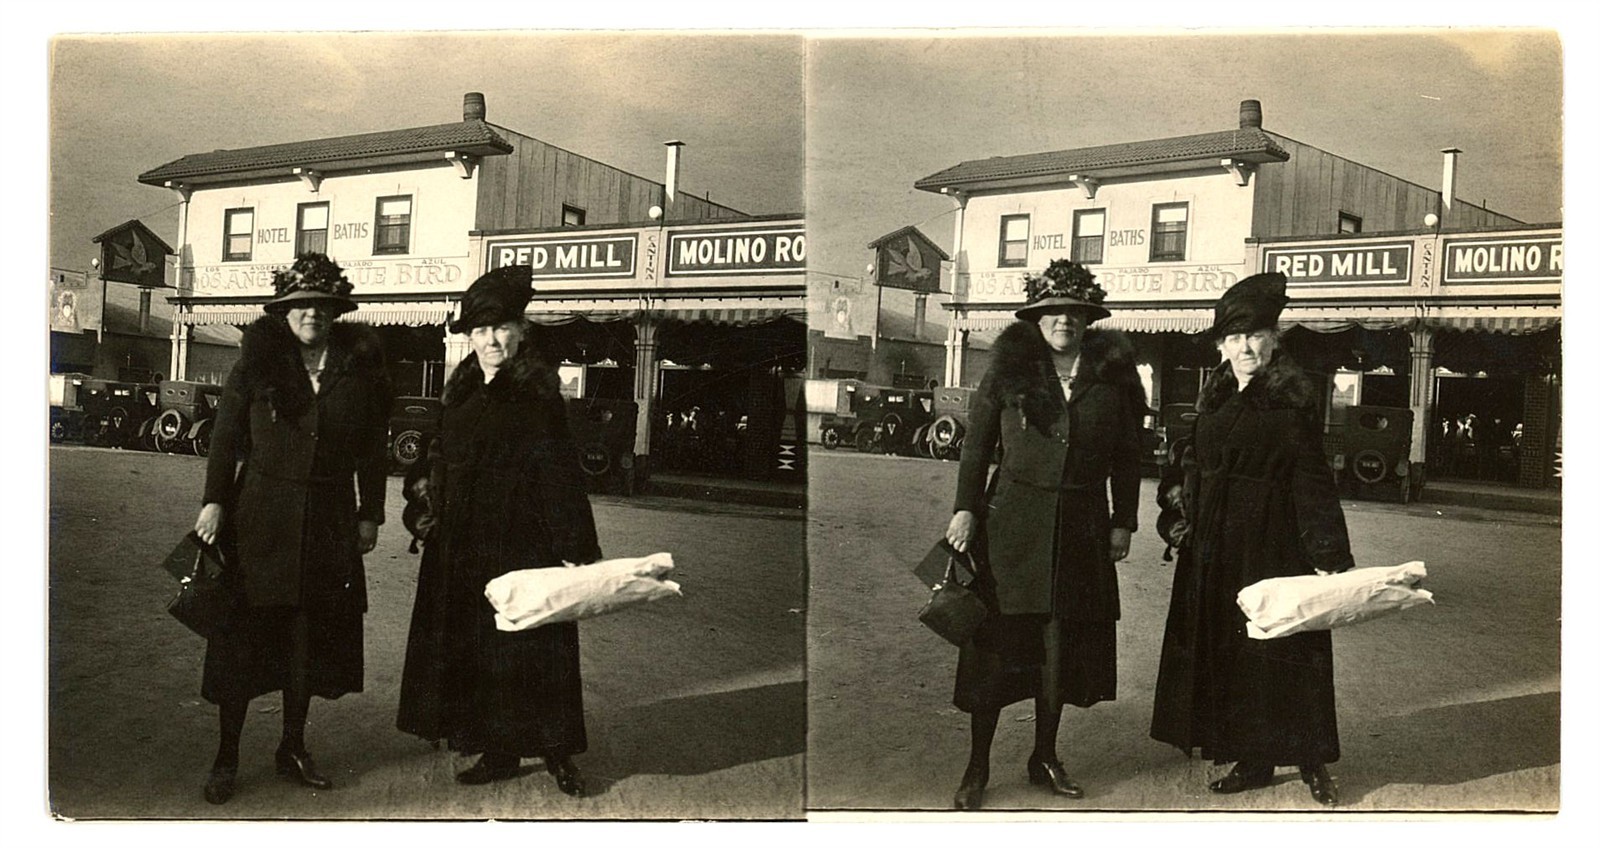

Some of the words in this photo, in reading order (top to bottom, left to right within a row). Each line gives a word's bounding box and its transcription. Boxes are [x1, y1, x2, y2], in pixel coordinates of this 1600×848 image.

[257, 227, 291, 244] HOTEL
[333, 222, 369, 240] BATHS
[1033, 233, 1067, 250] HOTEL
[1109, 229, 1146, 247] BATHS
[421, 257, 447, 265] AZUL
[499, 246, 549, 270] RED
[555, 243, 622, 269] MILL
[644, 234, 657, 281] CANTINA
[679, 236, 767, 265] MOLINO
[774, 235, 807, 263] RO
[1454, 245, 1542, 273] MOLINO
[393, 262, 462, 287] BIRD
[1275, 254, 1324, 278] RED
[1331, 251, 1398, 277] MILL
[1420, 242, 1433, 289] CANTINA
[1101, 271, 1163, 294] BLUE
[1169, 269, 1239, 293] BIRD
